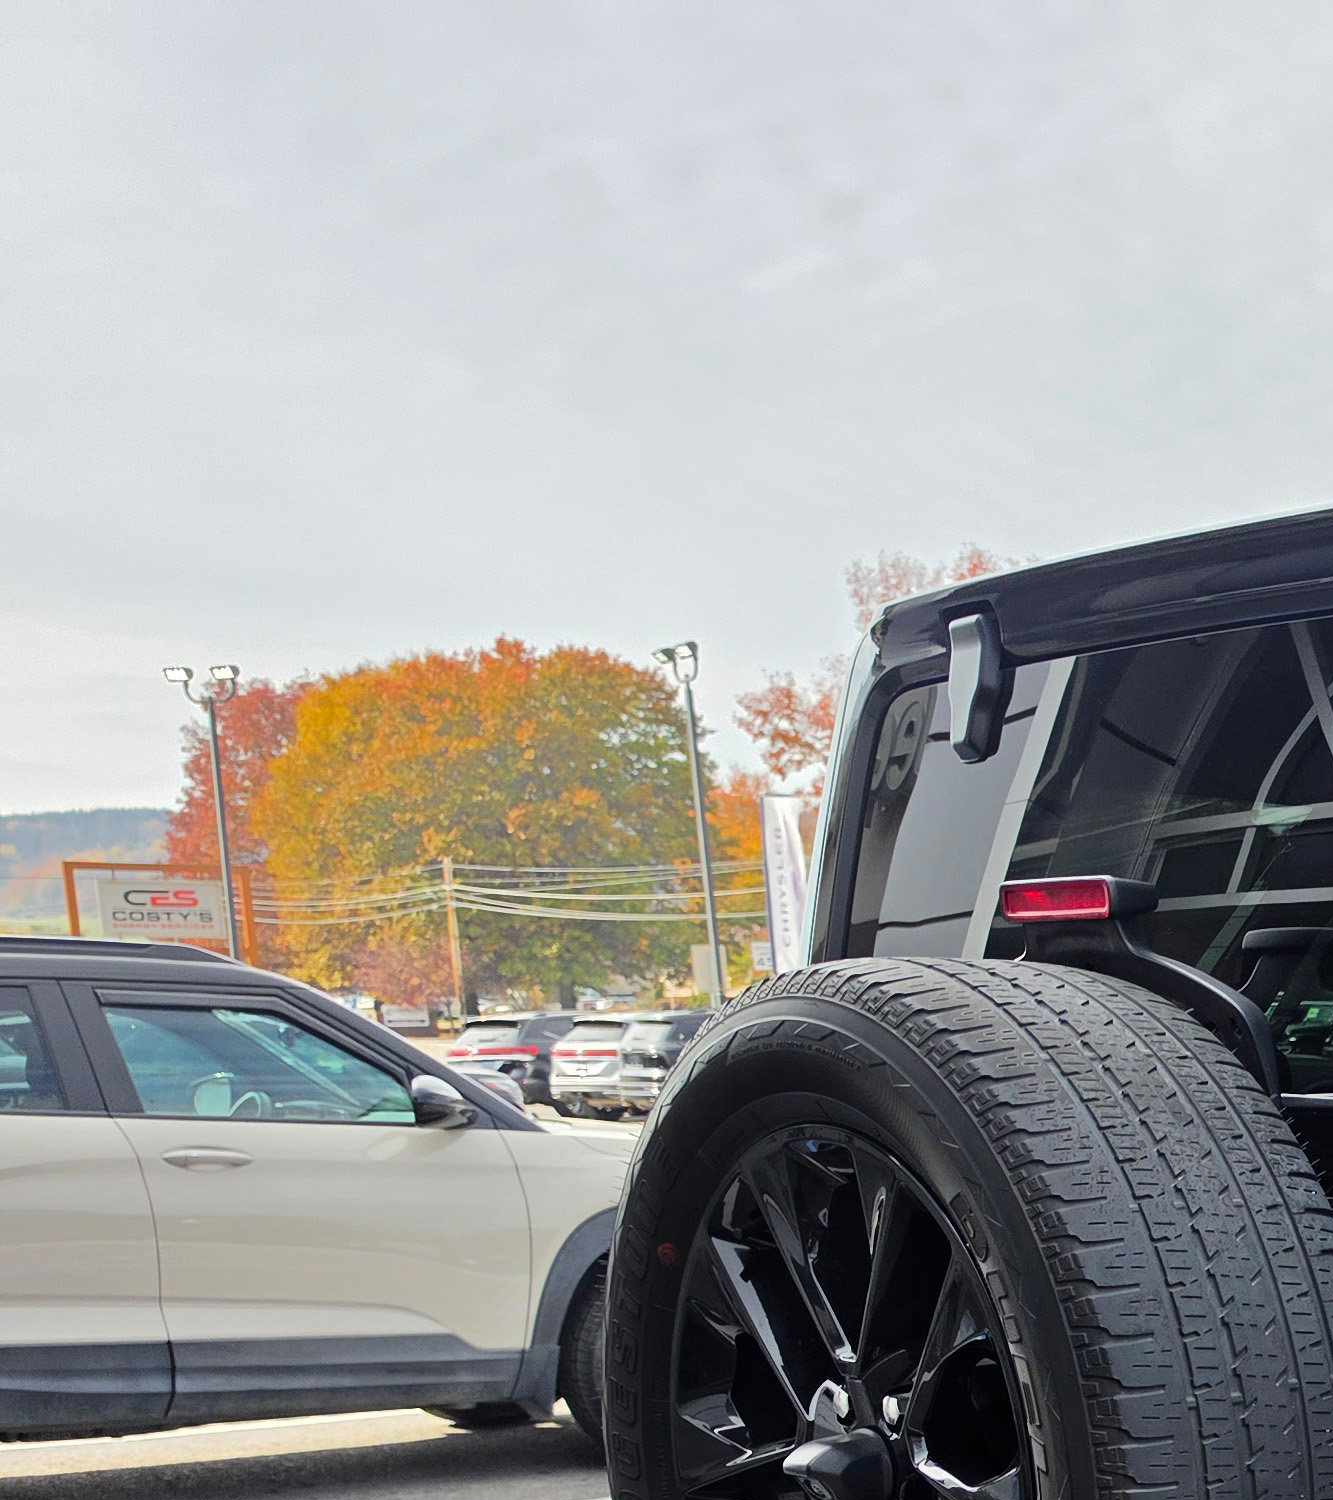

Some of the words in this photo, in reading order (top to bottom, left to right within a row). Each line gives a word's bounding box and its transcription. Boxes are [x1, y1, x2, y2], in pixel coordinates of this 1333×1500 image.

[773, 826, 791, 949] CHRYSLER
[123, 889, 199, 908] CES
[112, 911, 213, 923] COSTY'S
